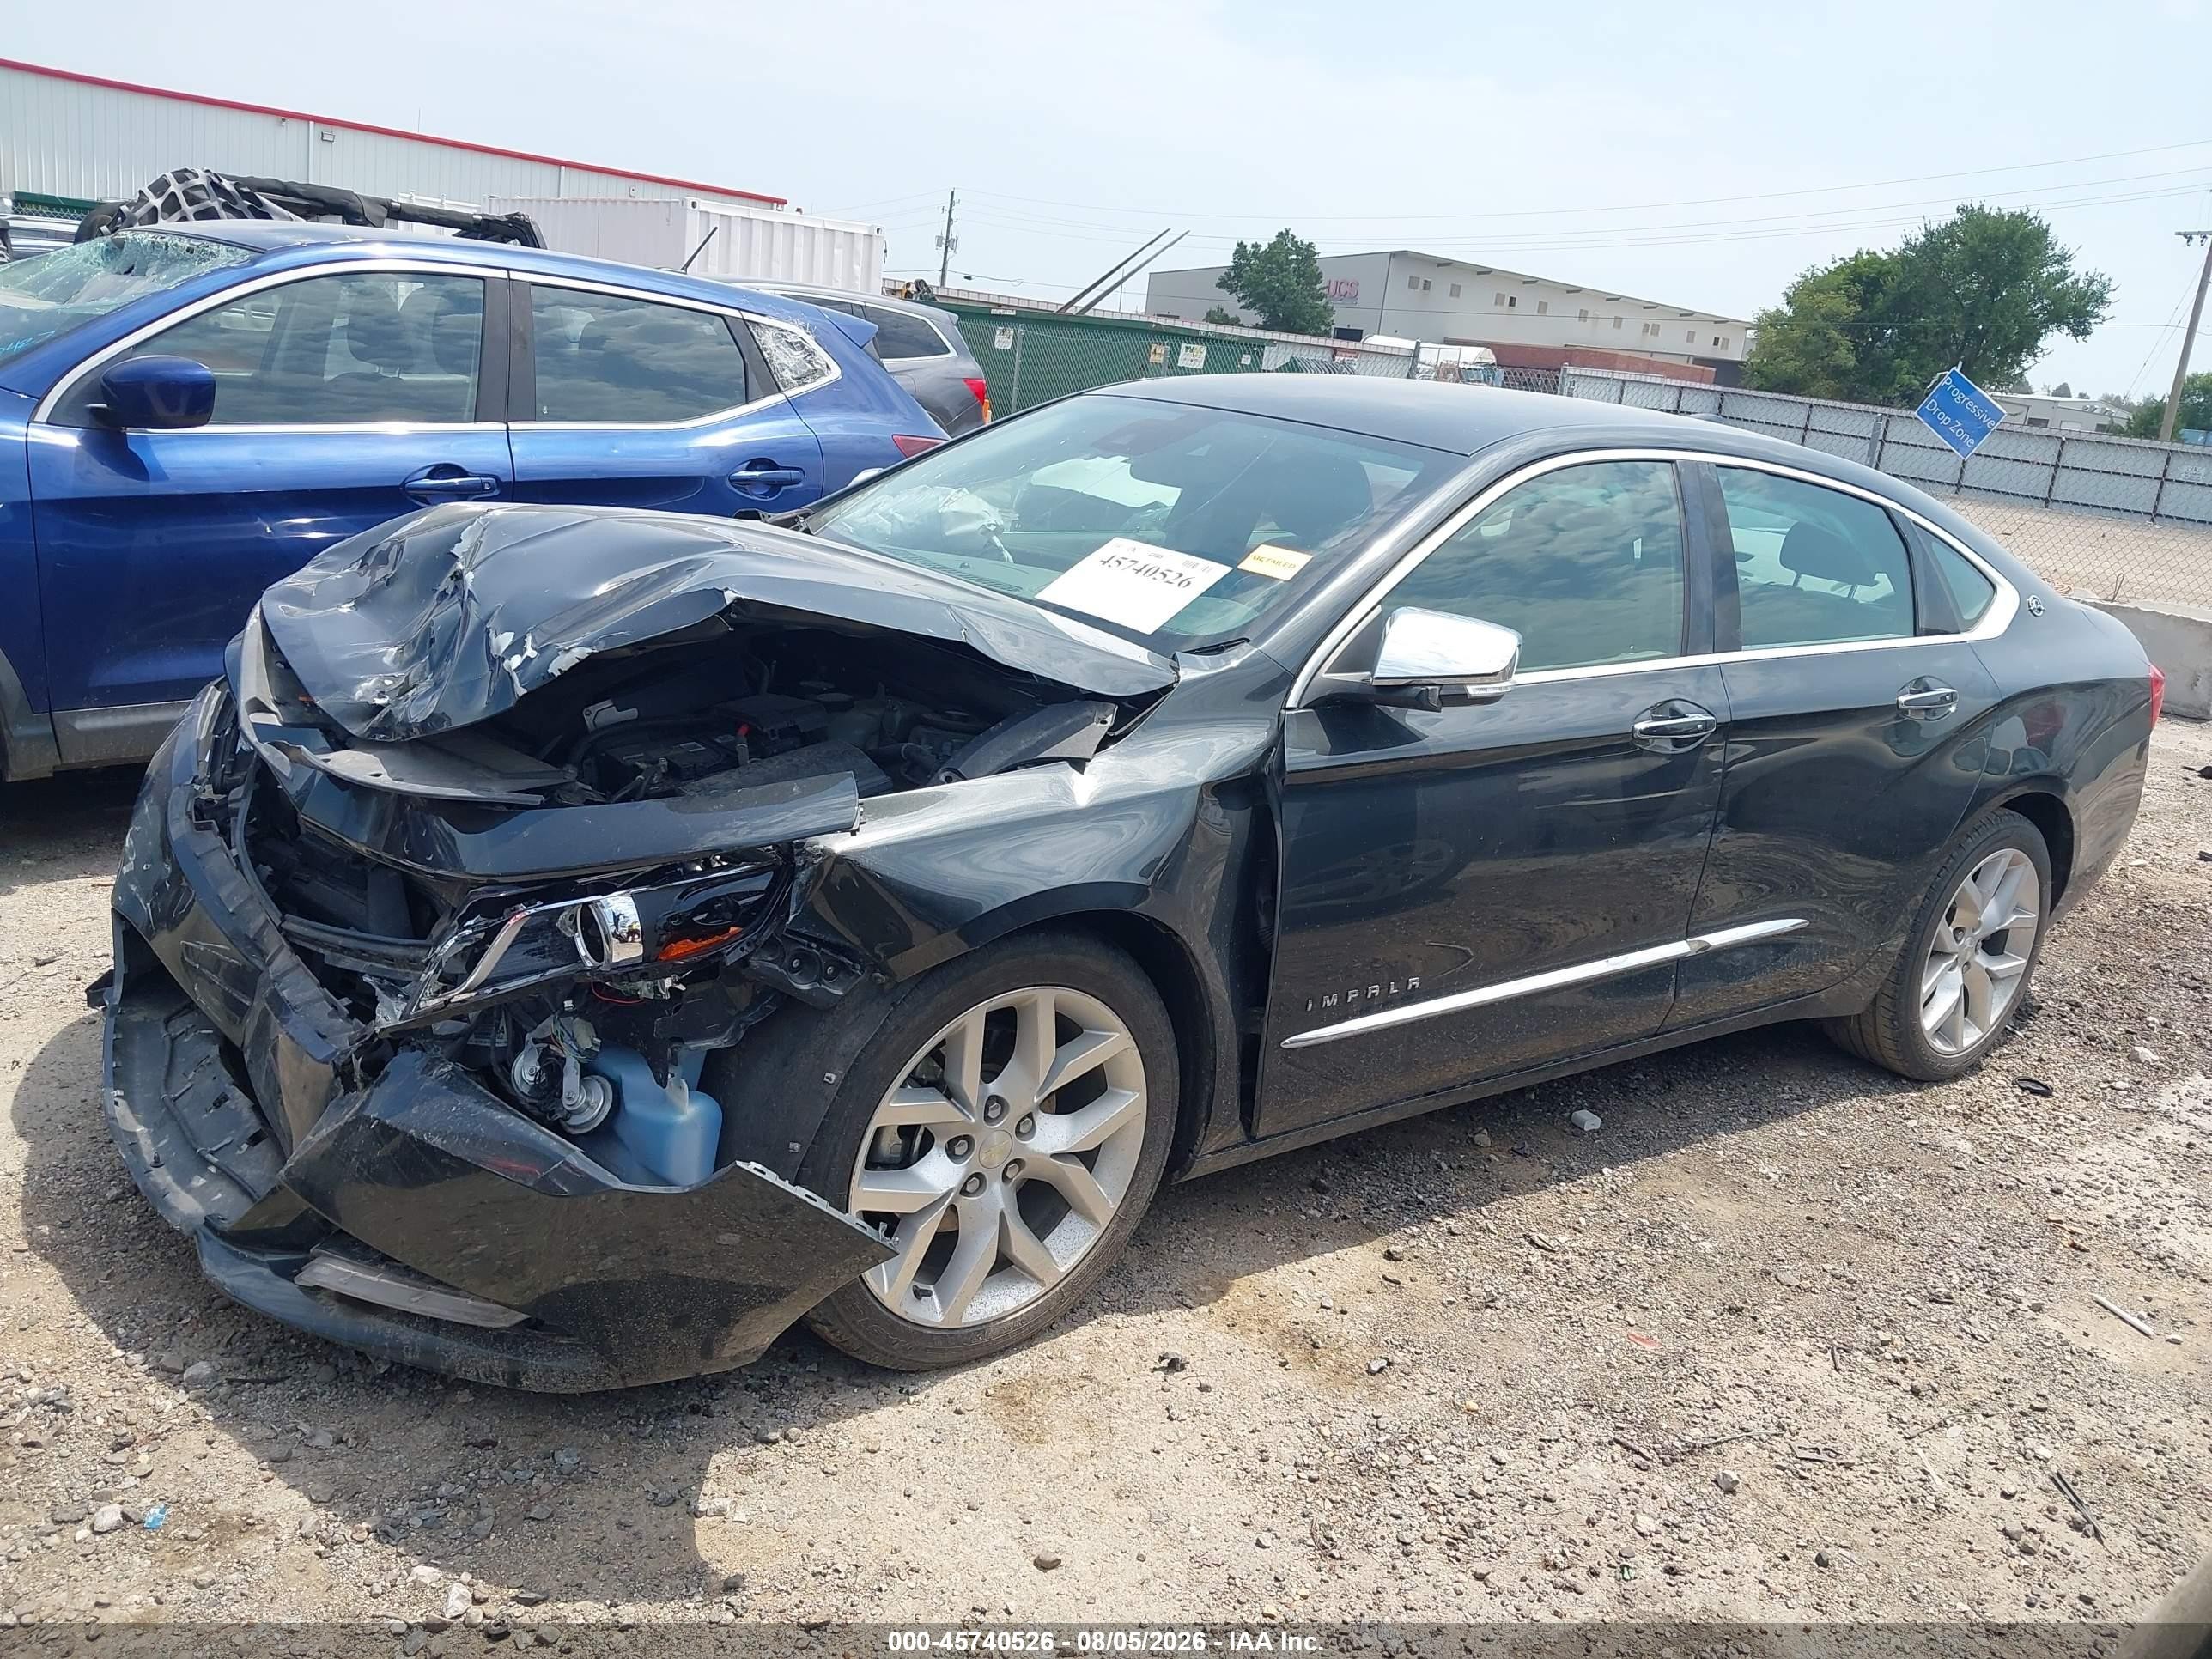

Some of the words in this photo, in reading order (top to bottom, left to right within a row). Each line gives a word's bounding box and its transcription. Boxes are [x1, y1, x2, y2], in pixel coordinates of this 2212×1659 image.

[1925, 399, 1952, 425] Drop
[1949, 420, 1975, 447] Zone
[1942, 377, 1996, 428] Progressive
[1099, 555, 1195, 588] 45740526
[1306, 976, 1420, 1012] IMPALA
